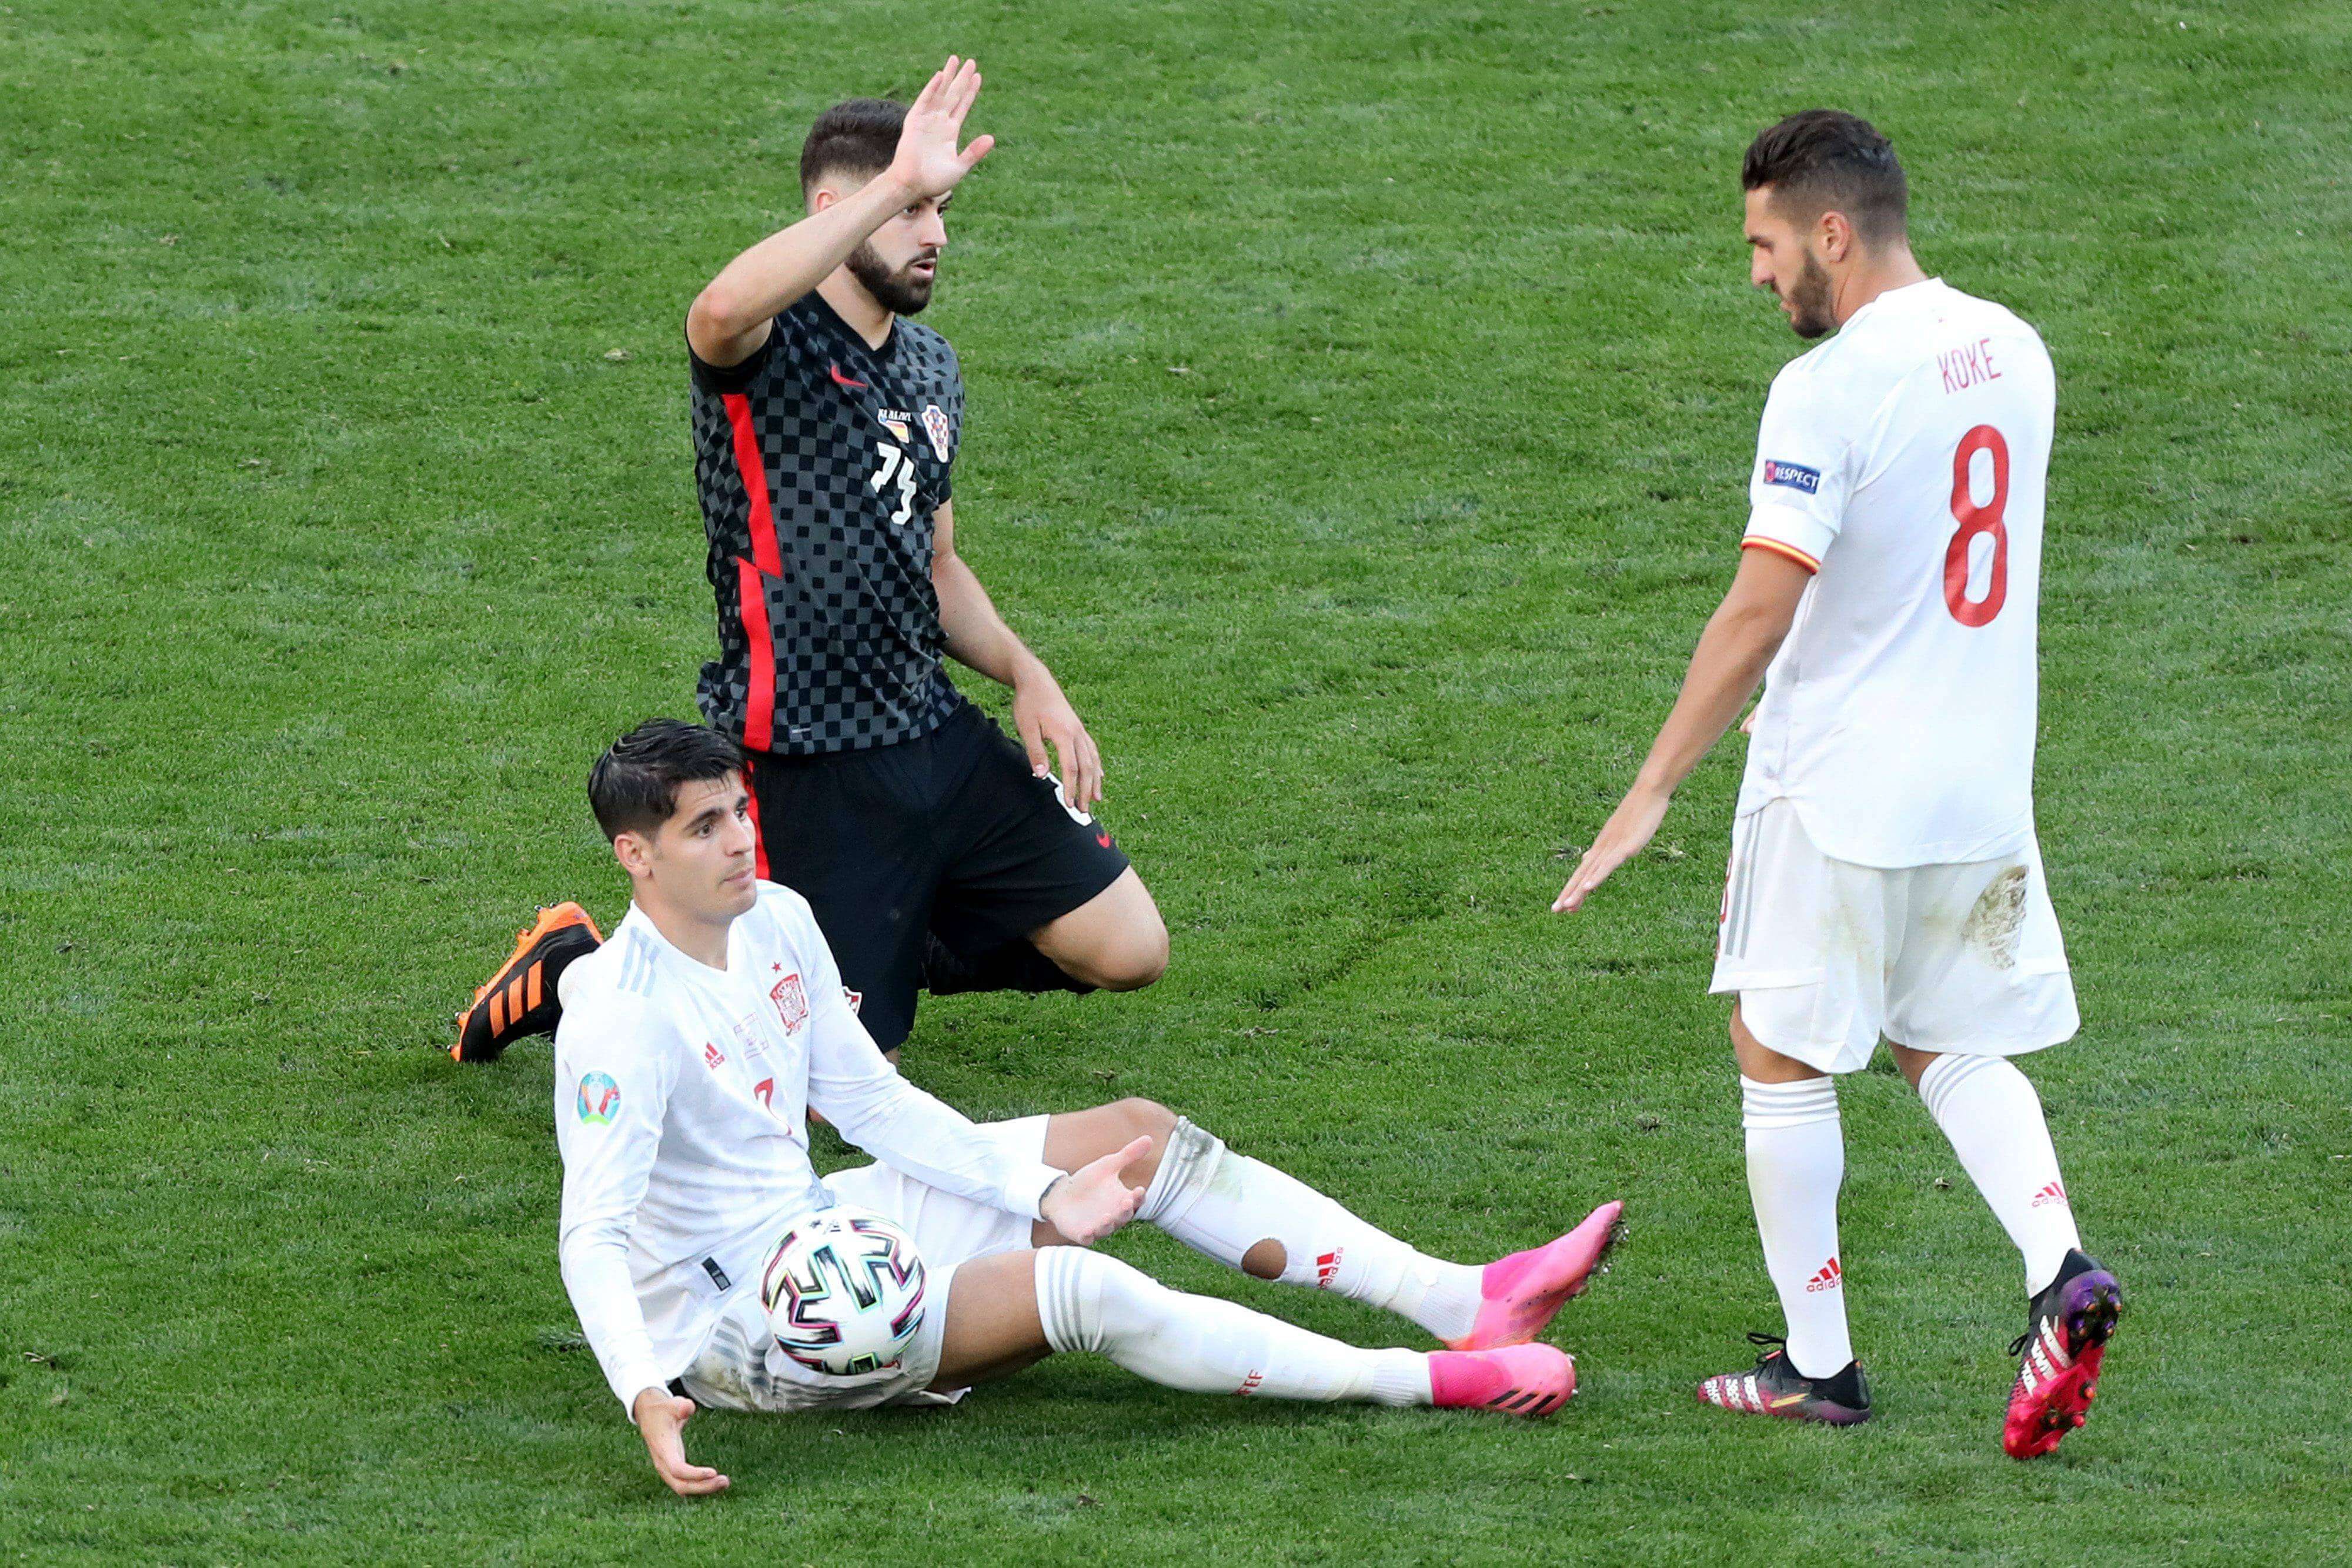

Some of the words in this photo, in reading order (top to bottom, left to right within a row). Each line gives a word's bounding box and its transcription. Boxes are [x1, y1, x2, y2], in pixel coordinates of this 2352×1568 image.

[1937, 337, 2003, 394] KOKE
[1775, 466, 1819, 489] RESPECT
[1944, 424, 2009, 627] 8
[754, 1077, 792, 1136] 7
[1237, 1369, 1264, 1395] FEF
